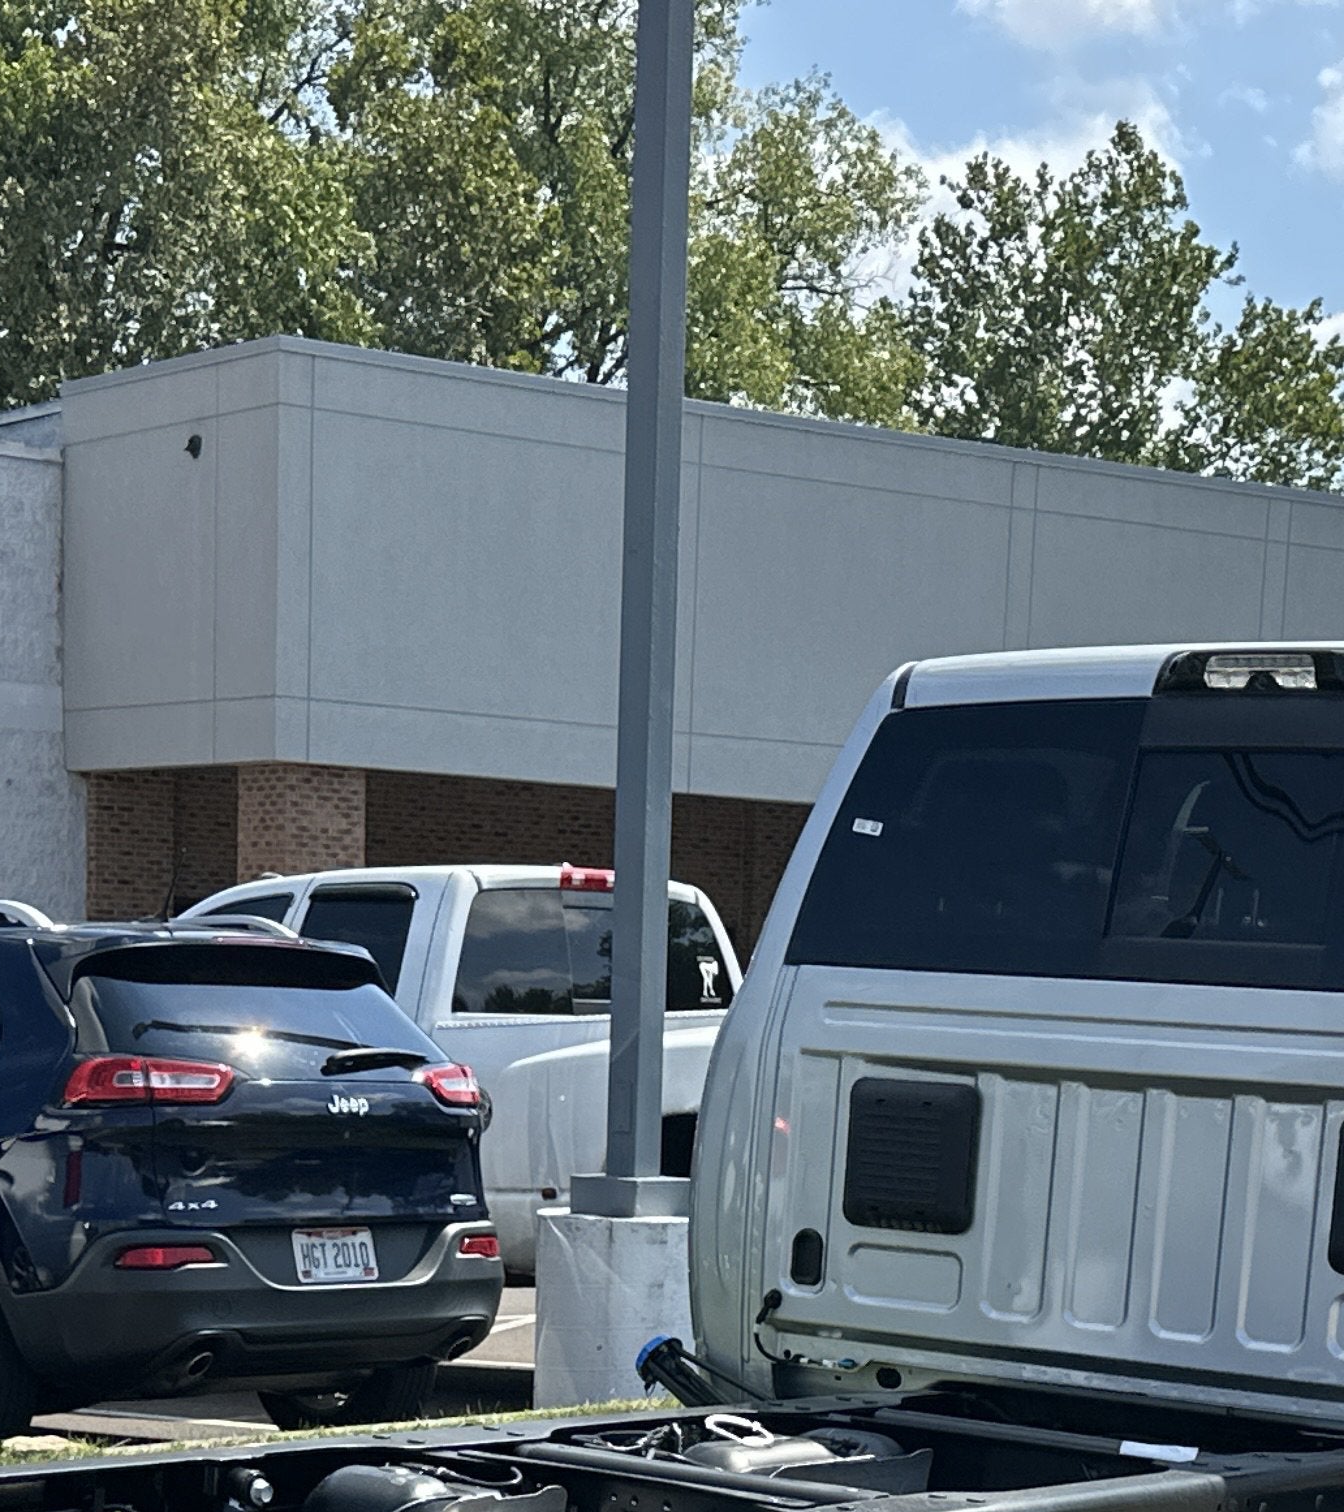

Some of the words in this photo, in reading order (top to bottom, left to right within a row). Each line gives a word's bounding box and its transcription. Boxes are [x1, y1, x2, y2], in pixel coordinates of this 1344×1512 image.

[327, 1095, 369, 1117] Jeep
[300, 1243, 327, 1269] HGT
[332, 1241, 370, 1268] 2010
